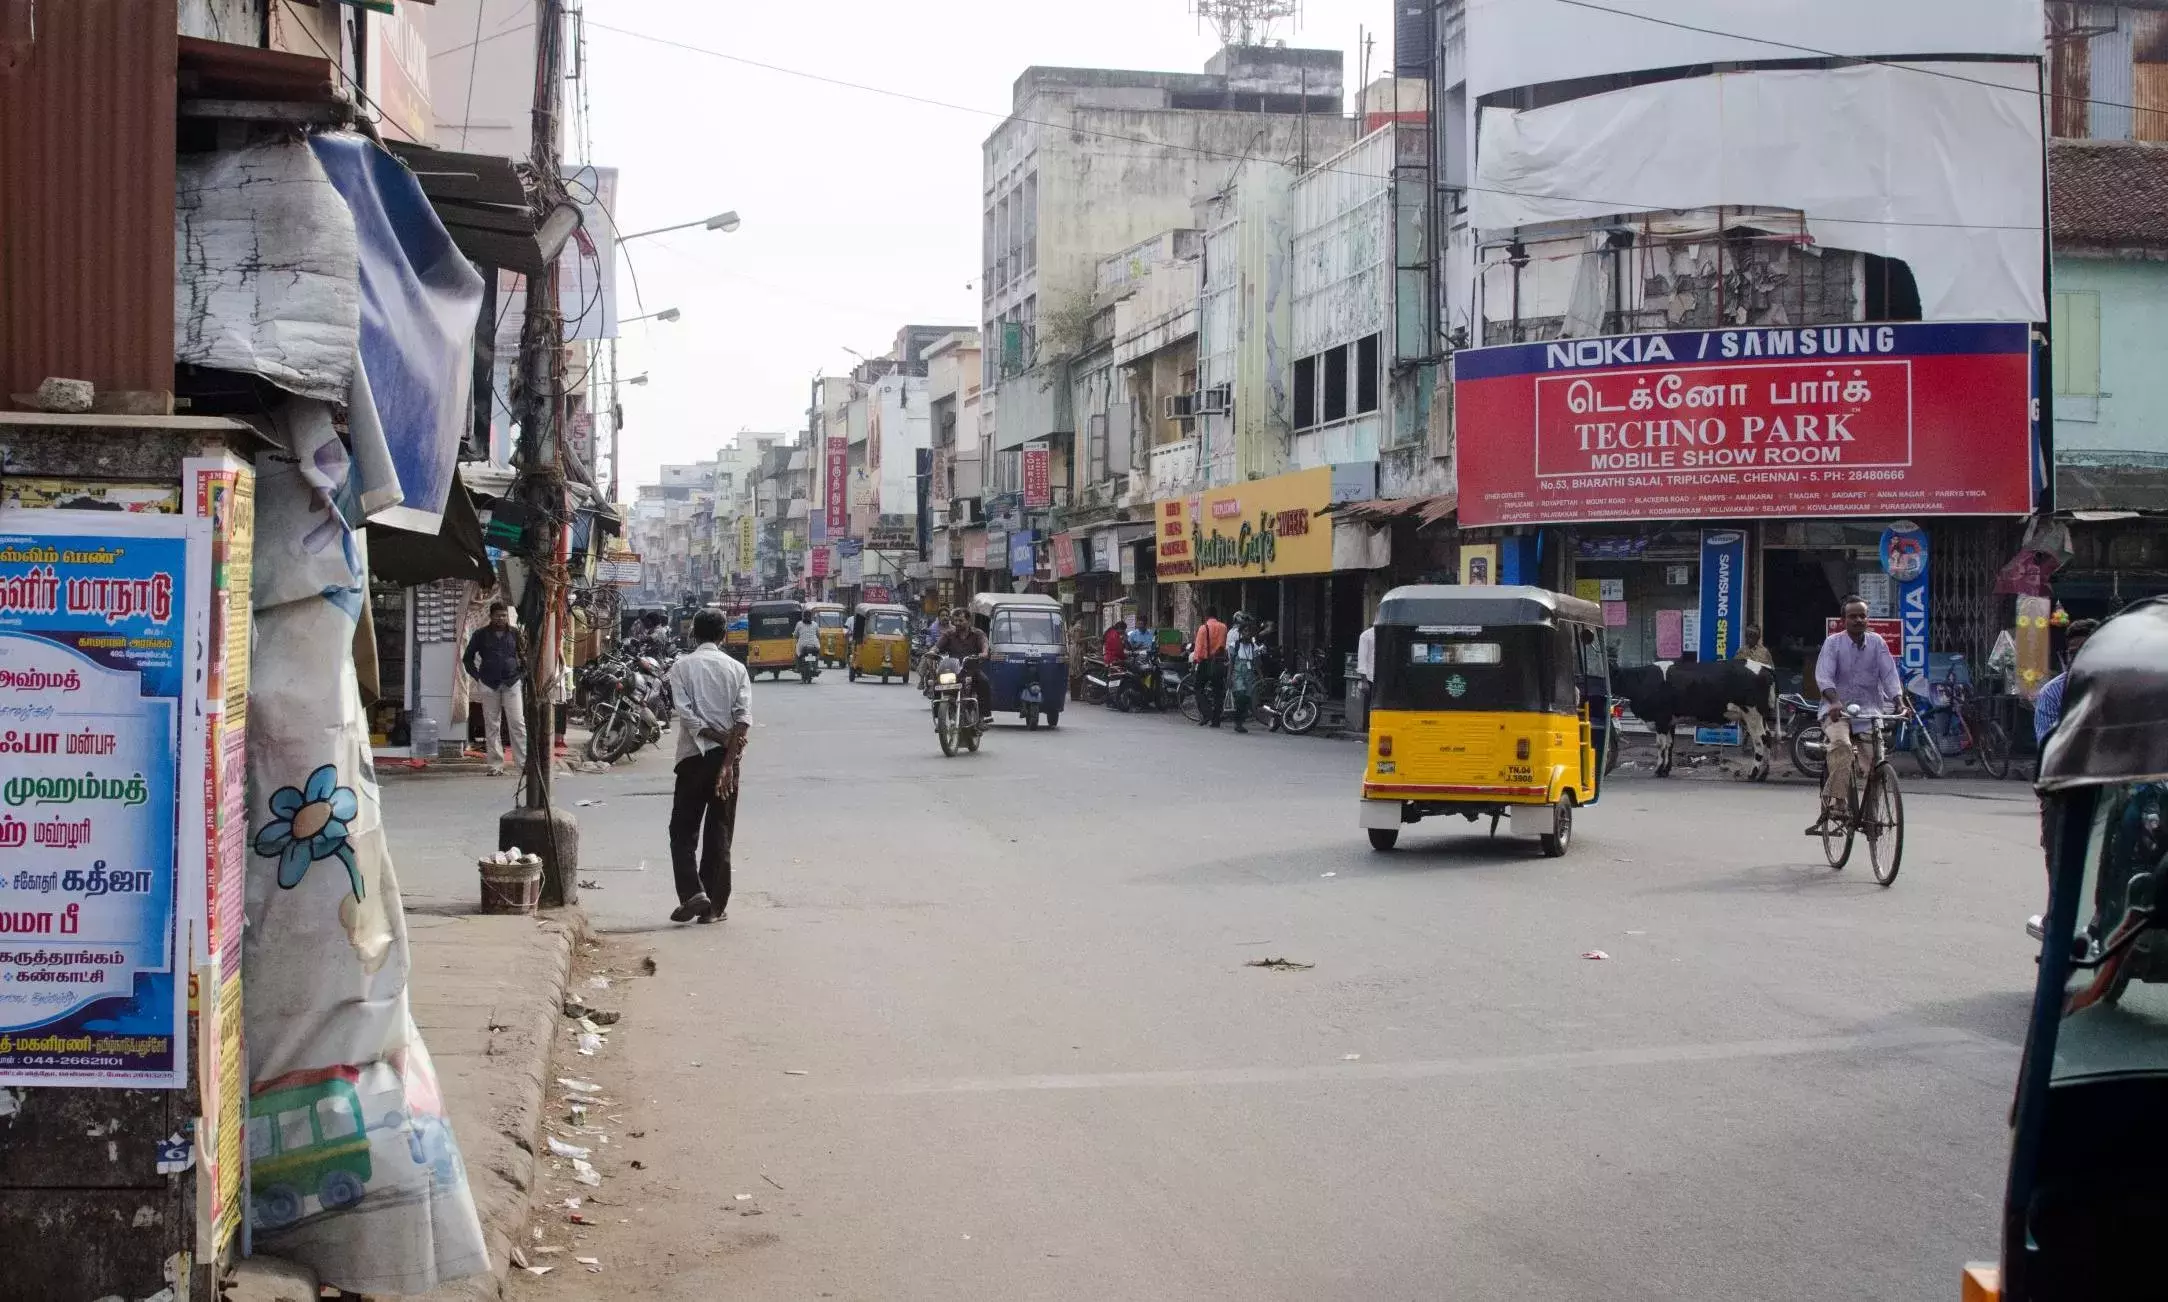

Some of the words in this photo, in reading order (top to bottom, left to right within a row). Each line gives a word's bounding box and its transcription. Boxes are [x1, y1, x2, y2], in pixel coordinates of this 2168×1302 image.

[1547, 336, 1675, 369] NOKIA
[1697, 333, 1710, 360] /
[1721, 326, 1895, 358] SAMSUNG
[1567, 374, 1748, 414] டெக்னோ
[1770, 369, 1872, 405] பார்க்
[1574, 416, 1727, 451] TECHNO
[1741, 413, 1856, 444] PARK
[1591, 451, 1676, 470] MOBILE
[1682, 448, 1757, 468] SHOW
[1764, 446, 1841, 464] ROOM
[1540, 480, 1570, 491] No.53,
[1572, 477, 1625, 490] BHARATHI
[1628, 475, 1663, 488] SALAI,
[1667, 473, 1740, 486] TRIPLICANE,
[1743, 472, 1800, 483] CHENNAI
[1823, 470, 1847, 481] PH:
[1848, 469, 1905, 480] 28480666
[1504, 501, 1534, 509] TRIPLICANE
[1877, 490, 1896, 498] ANNA
[66, 574, 174, 625] மாநாடு
[1717, 553, 1729, 617] SAMSUNG
[4, 771, 148, 809] முஹம்மத்
[13, 871, 58, 893] சகோதரி
[62, 859, 152, 899] கதீஜா
[60, 903, 80, 934] பீ
[16, 968, 104, 983] கண்காட்சி
[23, 1056, 124, 1066] 044-26621101
